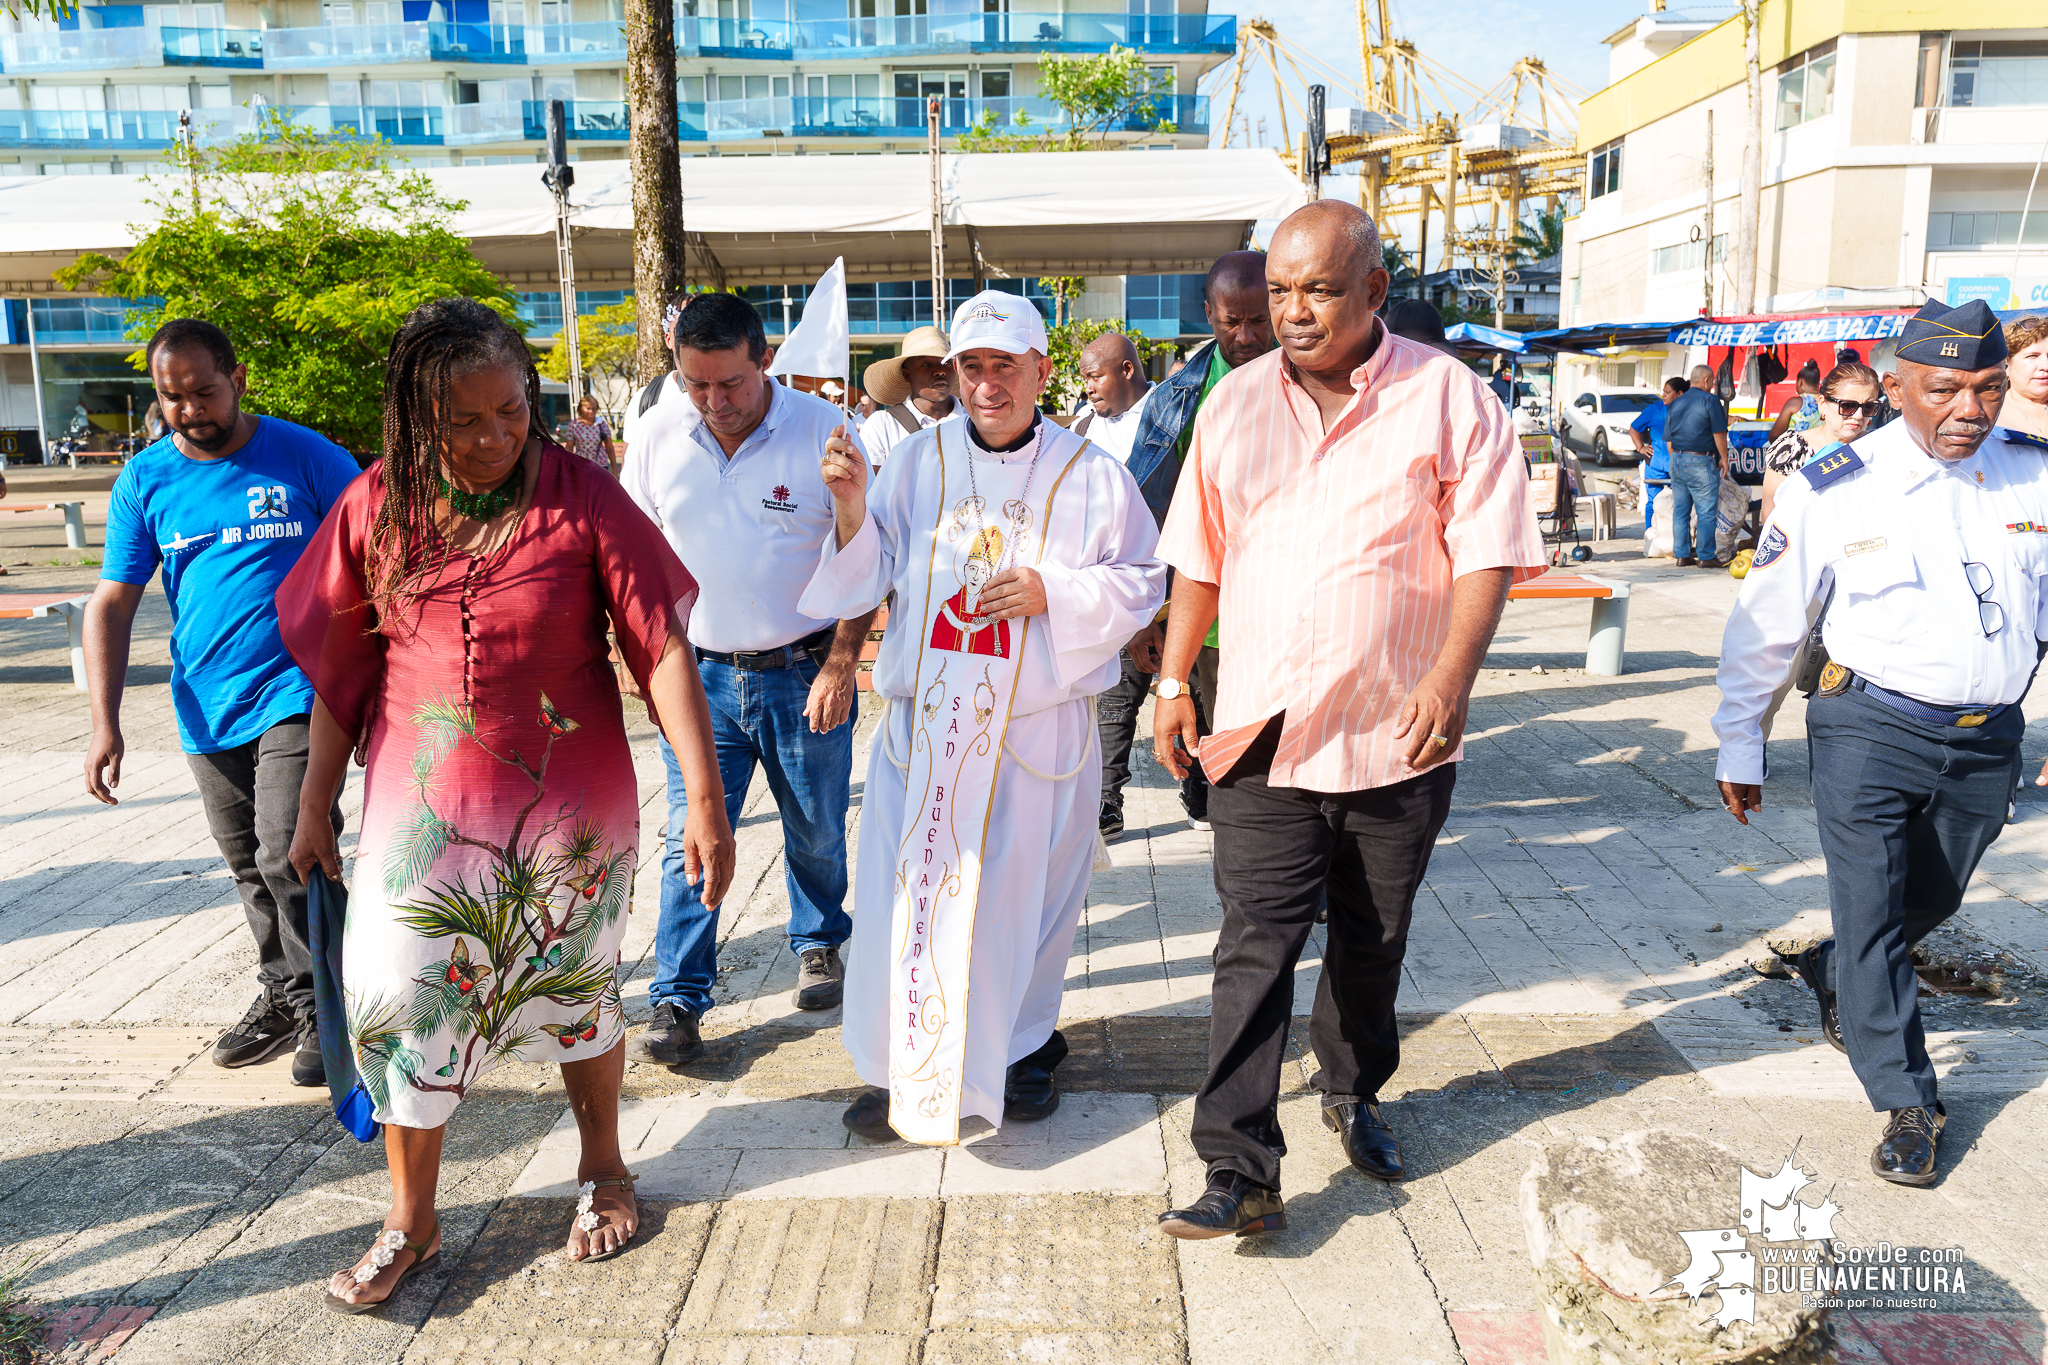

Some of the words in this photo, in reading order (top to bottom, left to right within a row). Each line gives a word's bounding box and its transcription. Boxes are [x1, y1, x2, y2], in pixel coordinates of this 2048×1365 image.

[1958, 285, 2000, 293] COOPERATIVA
[1674, 324, 1734, 346] AGUA
[1737, 322, 1770, 346] DE
[1835, 315, 1914, 340] VALEN
[247, 485, 290, 519] 23
[222, 527, 242, 544] AIR
[245, 521, 303, 541] JORDAN
[945, 696, 961, 760] SAN
[904, 785, 945, 1052] BUENAVENTURA
